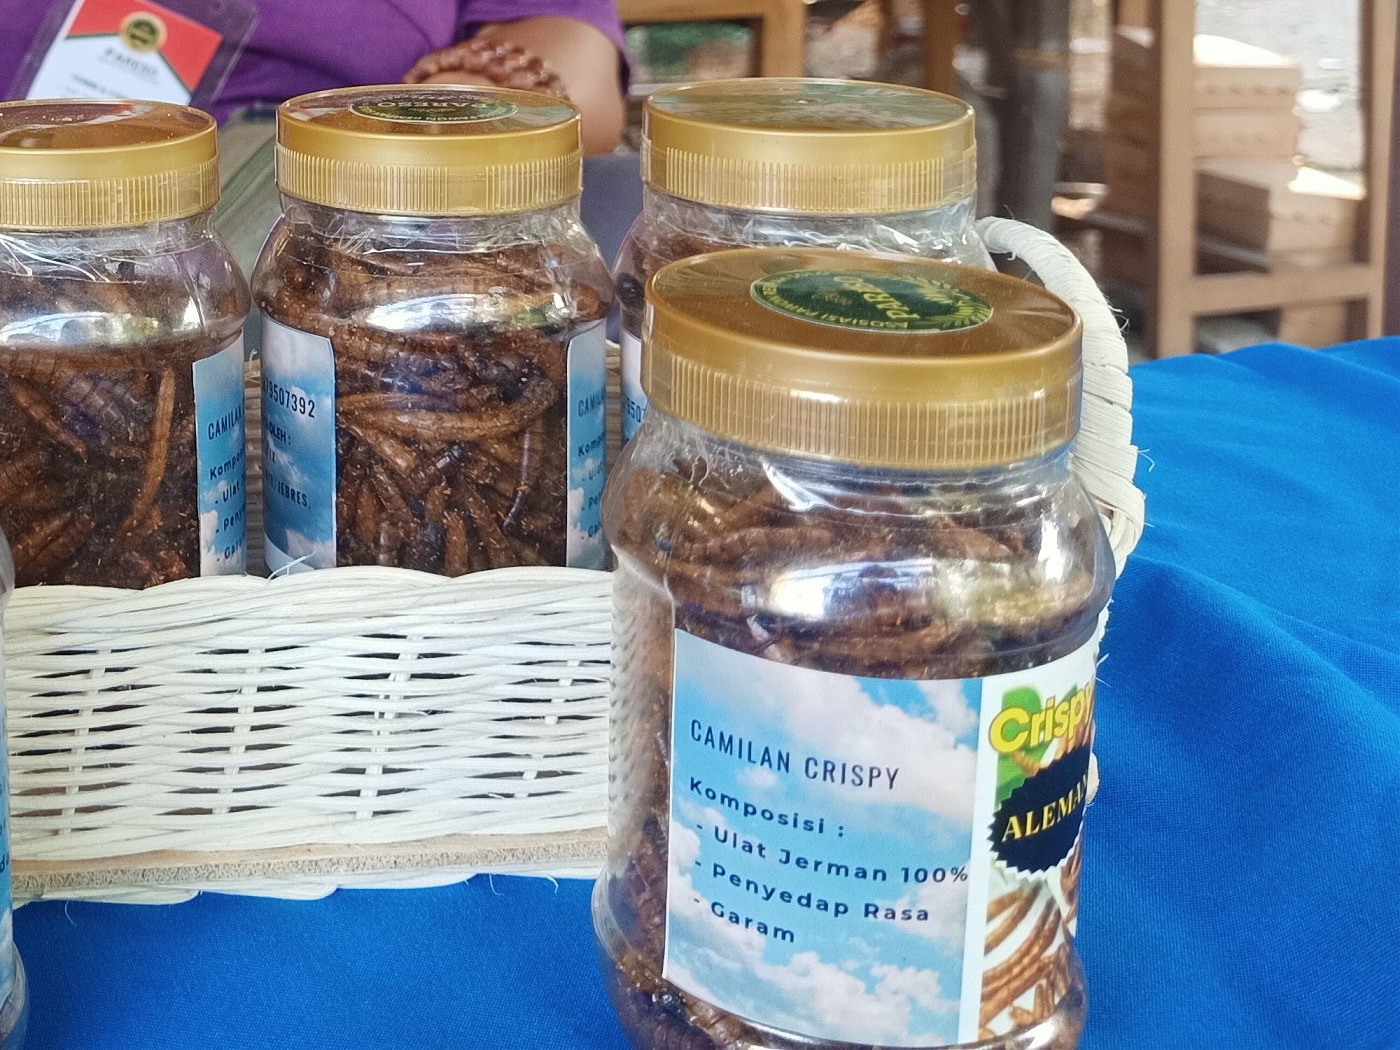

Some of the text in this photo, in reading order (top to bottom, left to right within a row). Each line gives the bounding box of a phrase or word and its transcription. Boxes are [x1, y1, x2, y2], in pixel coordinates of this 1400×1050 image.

[690, 719, 900, 790] CAMILAN CRISPY
[690, 776, 825, 835] Komposisi
[714, 825, 767, 860] Ulat
[778, 849, 888, 882] Jerman
[900, 865, 969, 884] 100%
[710, 901, 795, 943] Garam
[712, 862, 849, 917] Penyedap
[863, 902, 930, 923] Rasa
